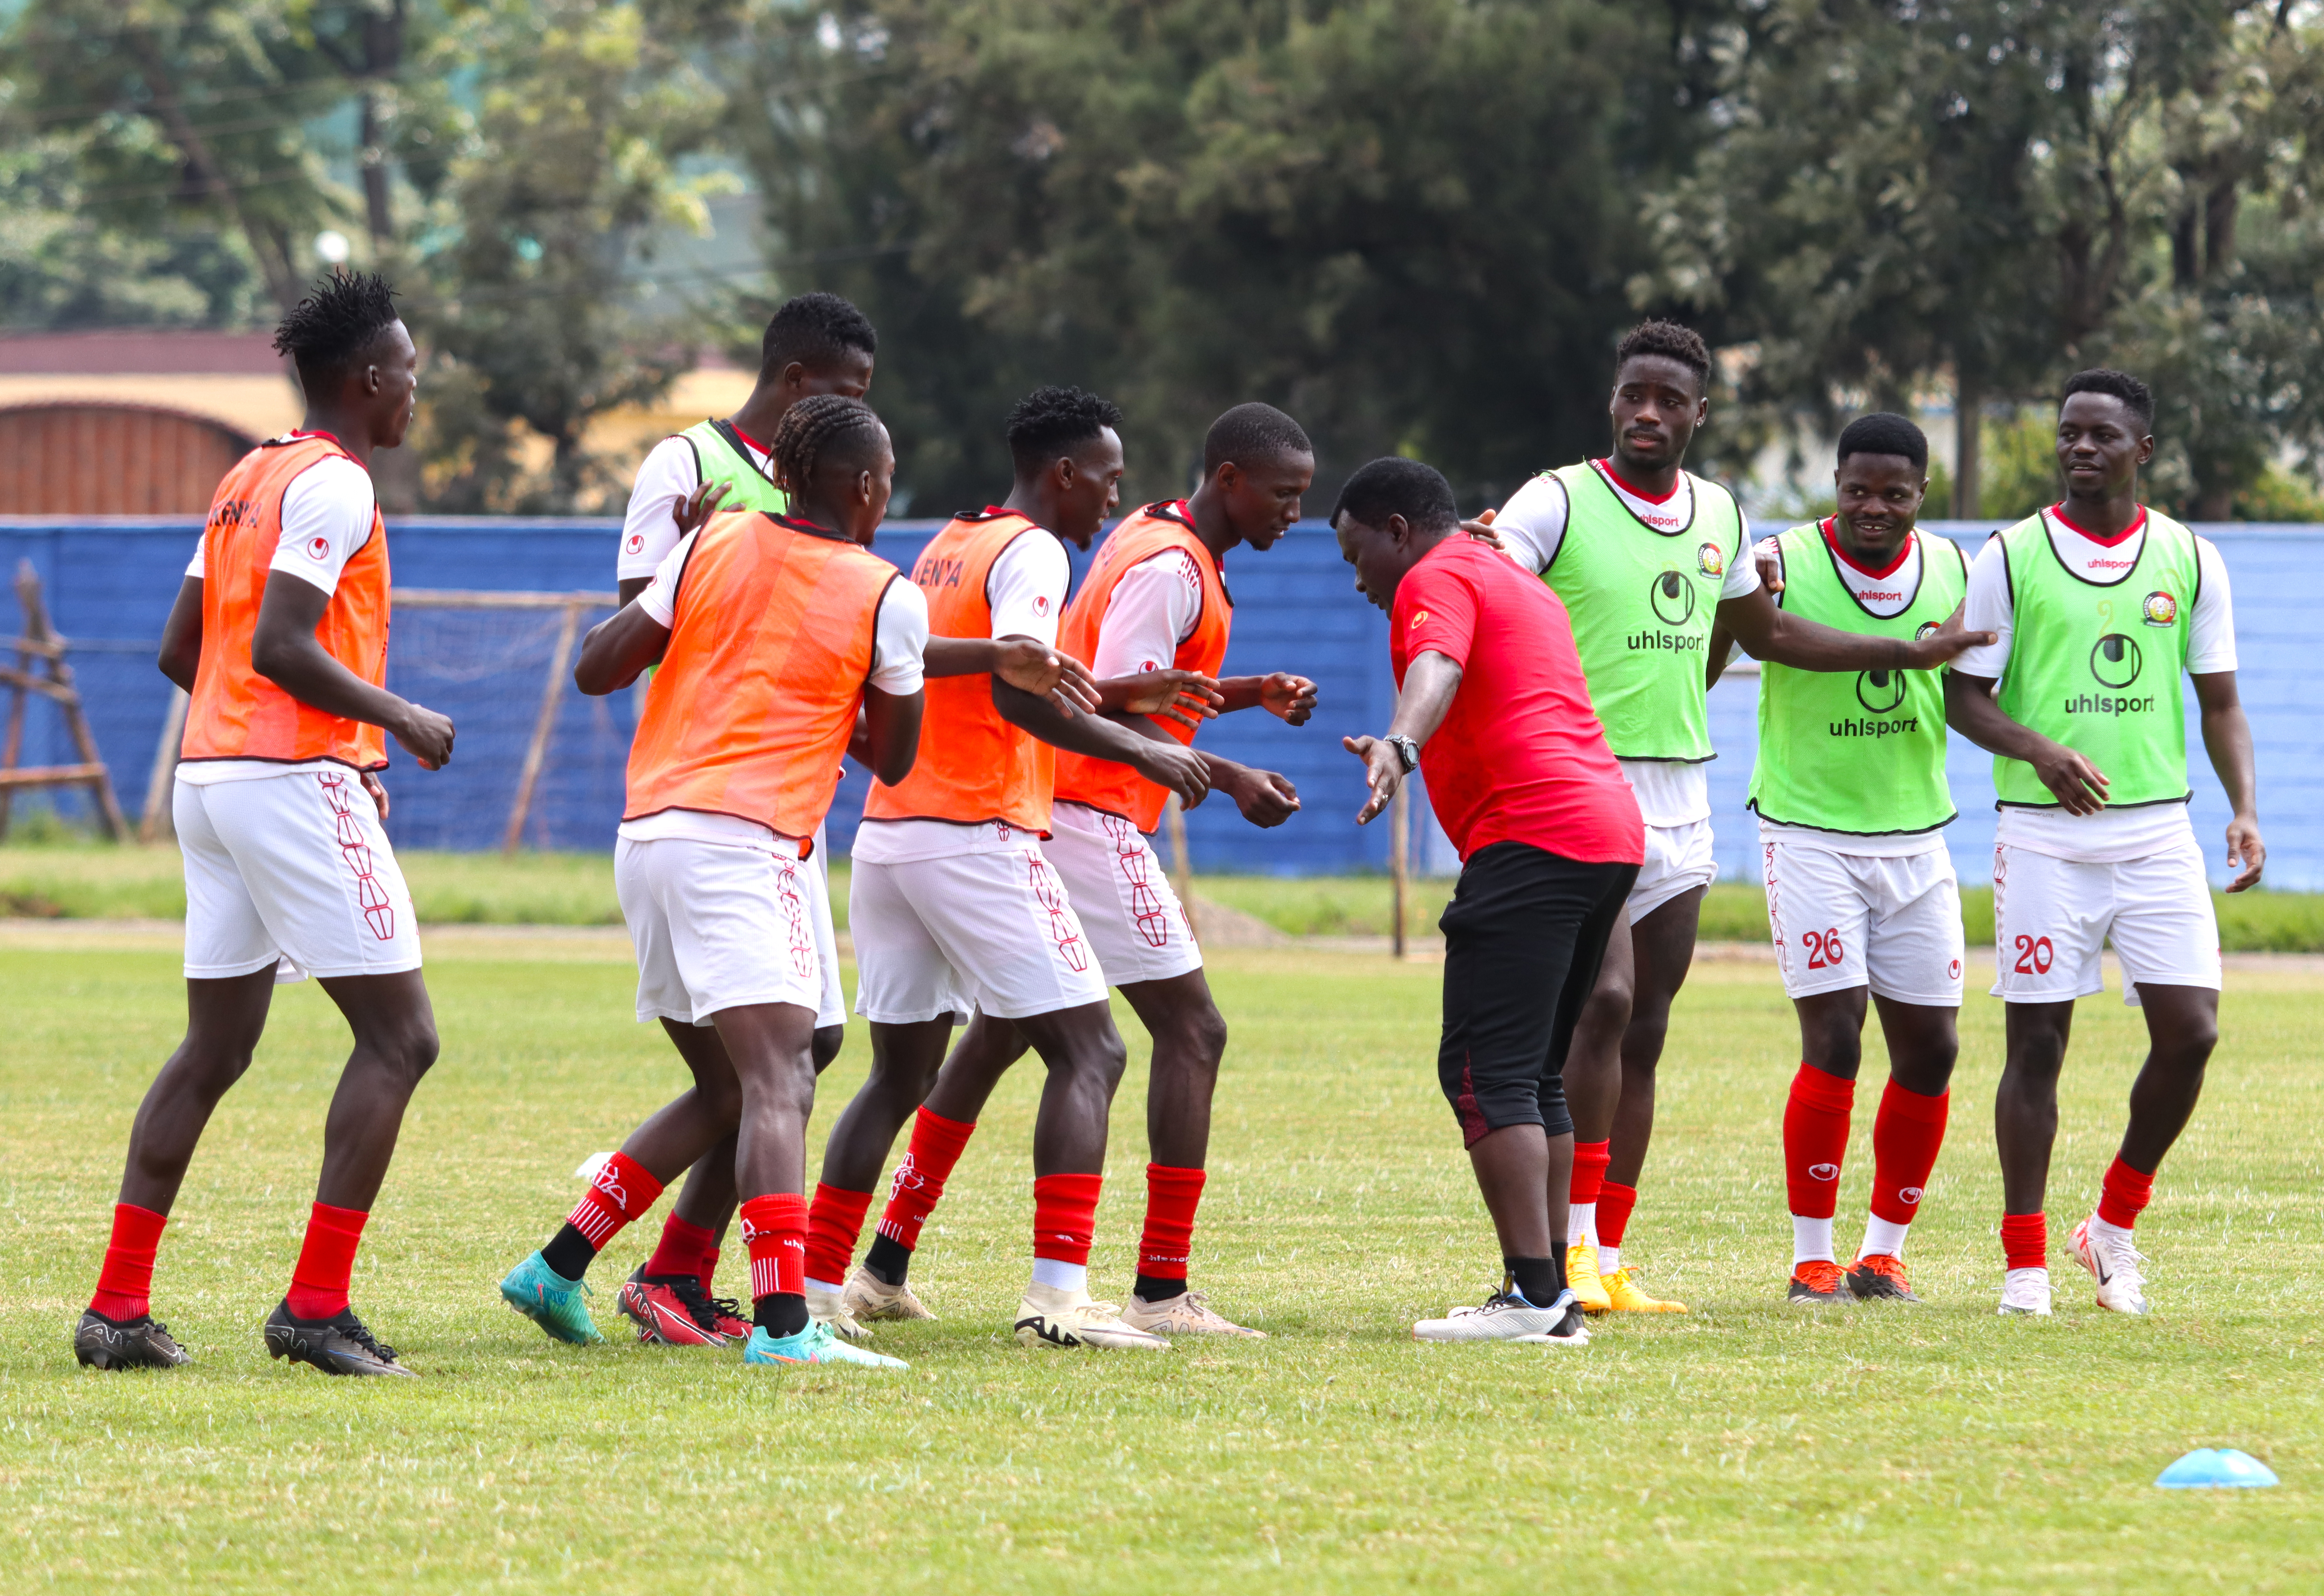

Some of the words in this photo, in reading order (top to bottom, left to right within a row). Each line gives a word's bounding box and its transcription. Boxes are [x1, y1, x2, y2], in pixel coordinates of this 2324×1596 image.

[1640, 514, 1679, 527] hlsport
[1628, 630, 1704, 654] uhlsport
[2065, 693, 2155, 717] uhlsport
[1830, 717, 1918, 739] uhlsport
[1803, 927, 1843, 969] 26
[2015, 935, 2054, 975] 20
